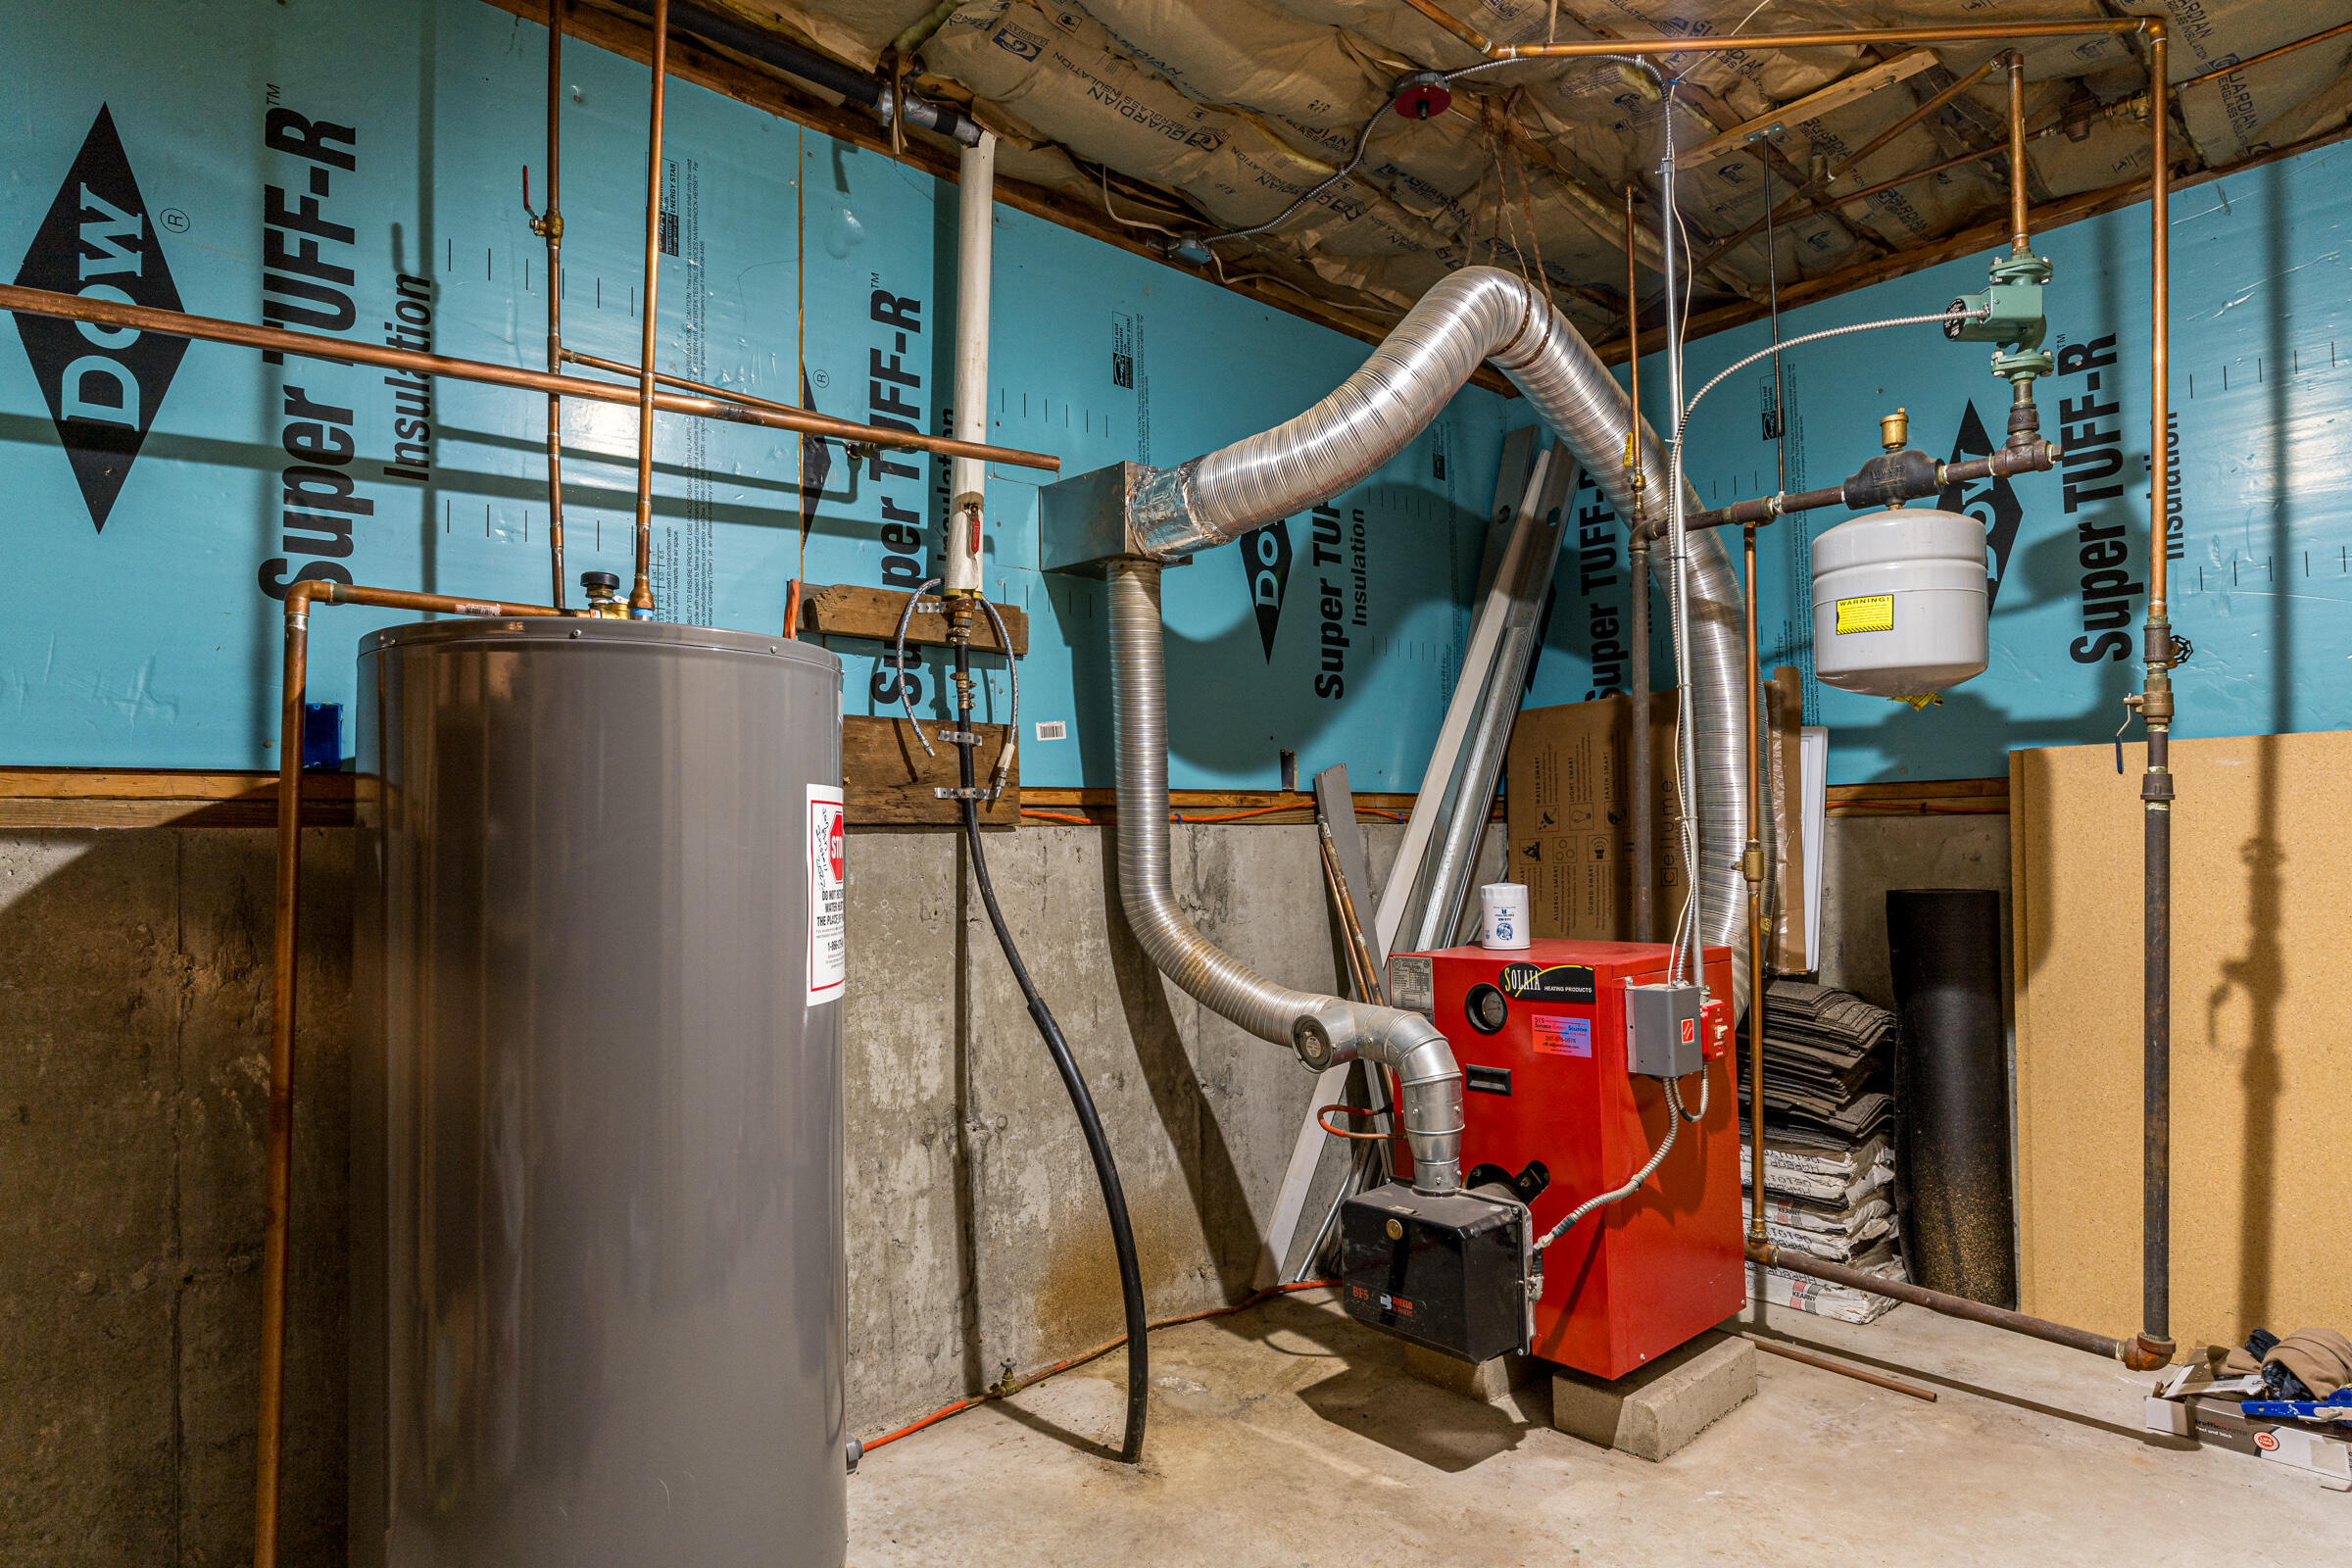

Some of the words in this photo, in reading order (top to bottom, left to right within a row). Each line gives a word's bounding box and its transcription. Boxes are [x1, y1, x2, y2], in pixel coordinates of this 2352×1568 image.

[1054, 51, 1122, 98] INSULATION
[2230, 69, 2258, 130] UARDIAN
[1087, 85, 1188, 141] GUARDIAN
[257, 385, 373, 606] Super
[1255, 521, 1278, 611] DO
[1350, 508, 1367, 627] Insulation
[2070, 521, 2144, 663] Super
[1839, 597, 1888, 606] WARNING!
[1314, 578, 1349, 700] Super
[1585, 604, 1628, 702] Super
[817, 915, 826, 926] THE
[1504, 967, 1541, 992] SOLAIA
[1352, 1286, 1369, 1300] BF5
[1393, 1297, 1413, 1309] RIELLO
[1792, 1292, 1816, 1301] KEARNY
